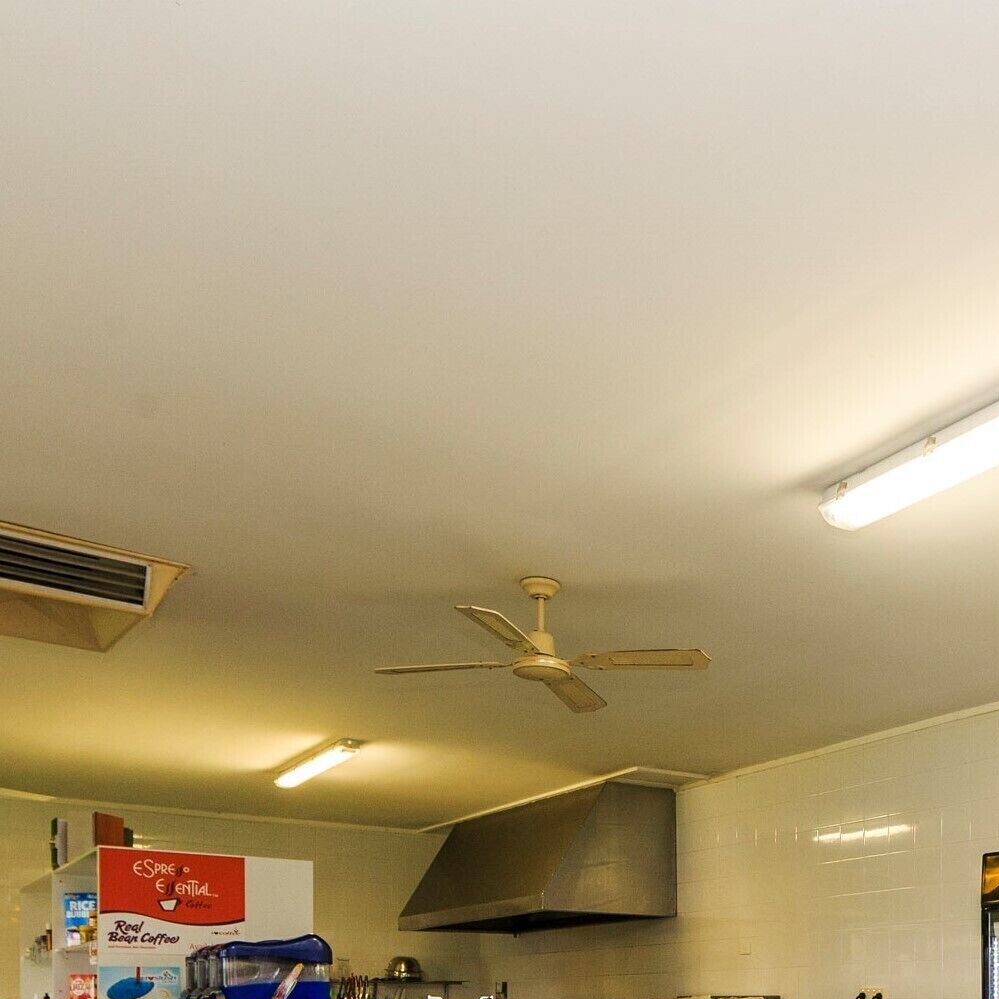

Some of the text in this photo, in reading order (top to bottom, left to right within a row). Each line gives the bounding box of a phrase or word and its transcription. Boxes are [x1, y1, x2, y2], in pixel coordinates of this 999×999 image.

[70, 900, 96, 911] RICE
[114, 919, 144, 936] Real
[107, 931, 138, 944] Bean
[140, 932, 180, 946] Coffee
